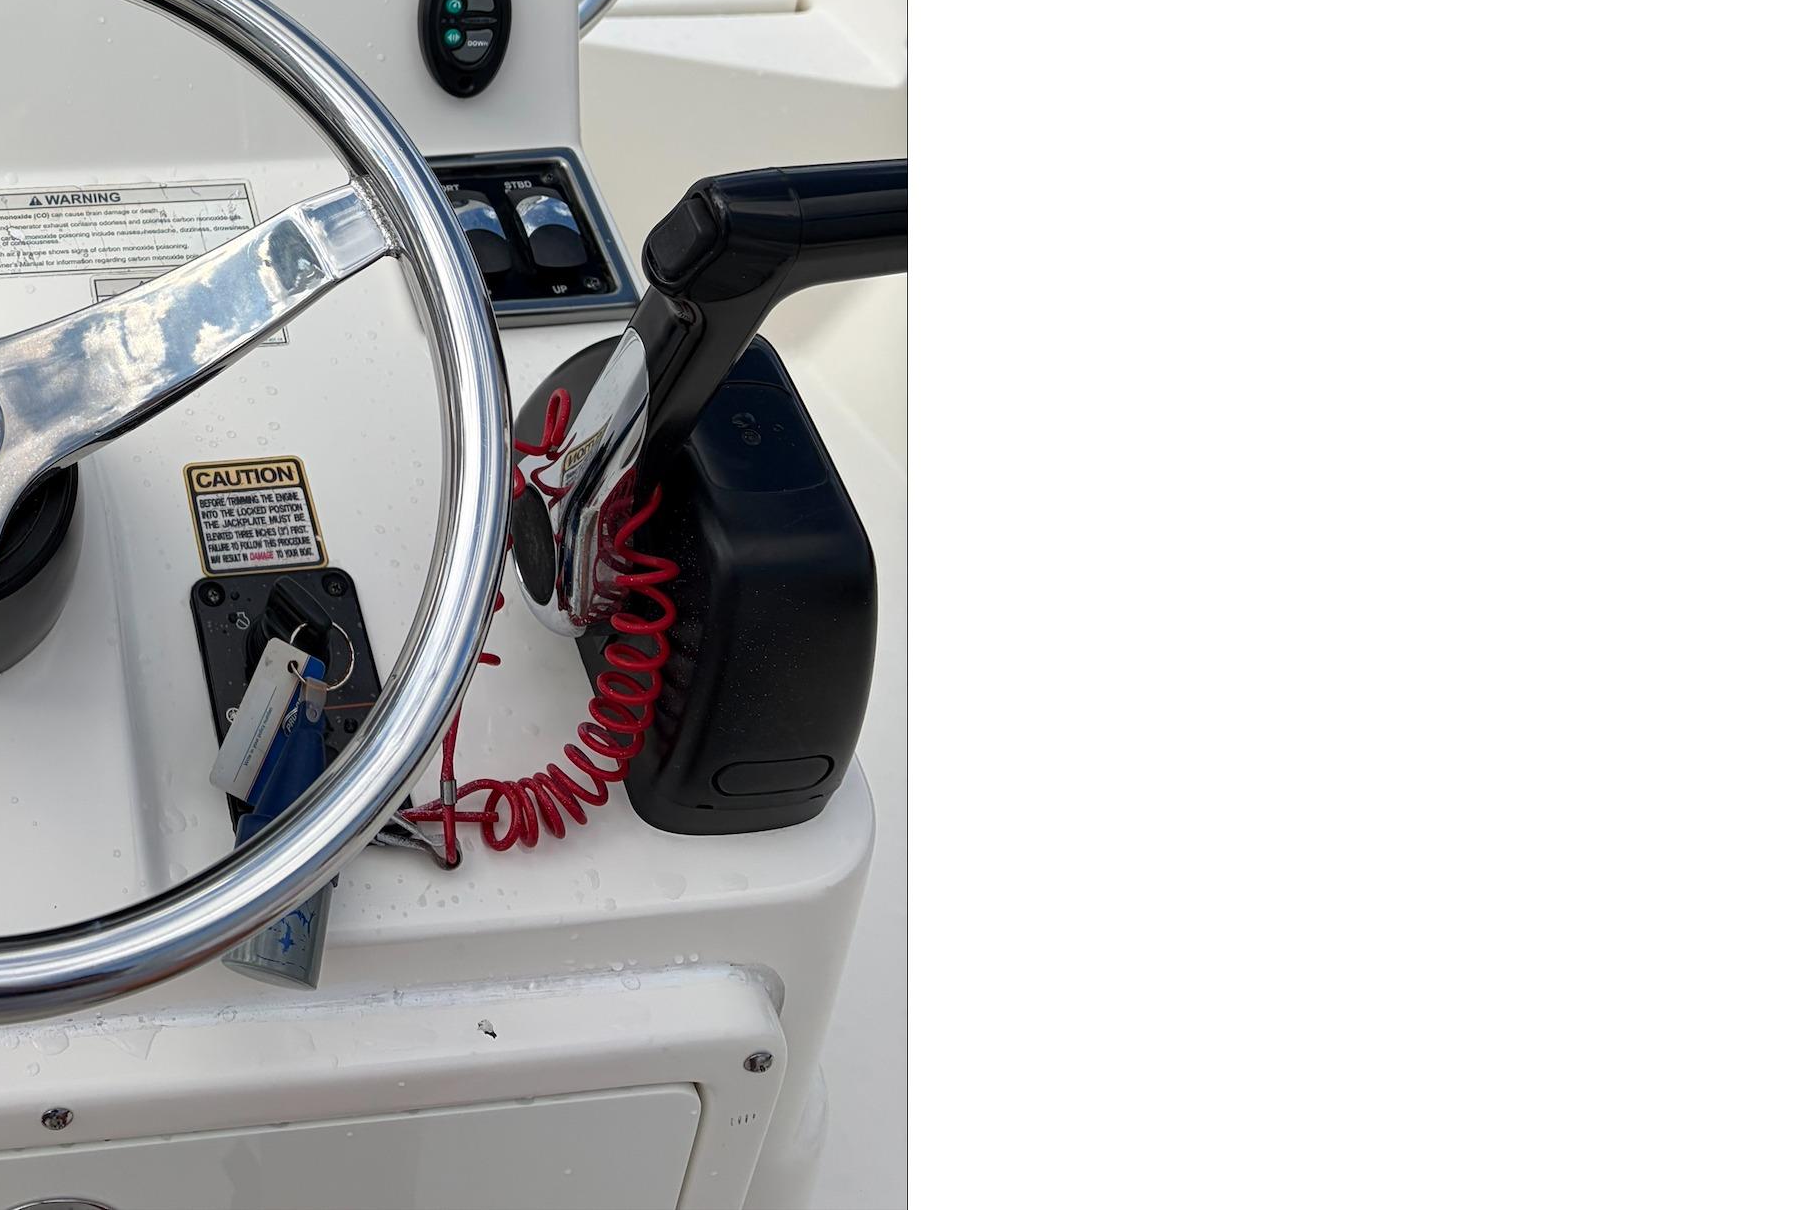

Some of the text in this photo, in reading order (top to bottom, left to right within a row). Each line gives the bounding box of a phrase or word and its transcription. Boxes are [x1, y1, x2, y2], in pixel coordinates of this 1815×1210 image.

[504, 180, 532, 190] STBD
[44, 191, 120, 205] WARNING
[33, 212, 49, 220] (CO)
[103, 208, 129, 216] damage
[552, 285, 568, 294] UP
[196, 465, 294, 488] CAUTION
[199, 491, 300, 508] BEFORE TRIMMING THE ENGINE
[201, 503, 303, 519] INTO THE LOCKED POSITION
[204, 513, 306, 530] THE JACKPLATE MUST BE
[206, 532, 233, 541] ELEVATED
[234, 530, 254, 539] THREE
[255, 528, 277, 537] INCHES
[291, 525, 308, 534] FIRST.
[208, 543, 230, 553] FAILURE
[240, 540, 263, 550] FOLLOW
[264, 539, 277, 548] THIS
[277, 536, 311, 547] PROCEDURE
[210, 556, 221, 564] MAY
[222, 554, 242, 563] RESULT
[249, 551, 274, 560] DAMAGE
[284, 549, 299, 557] YOUR
